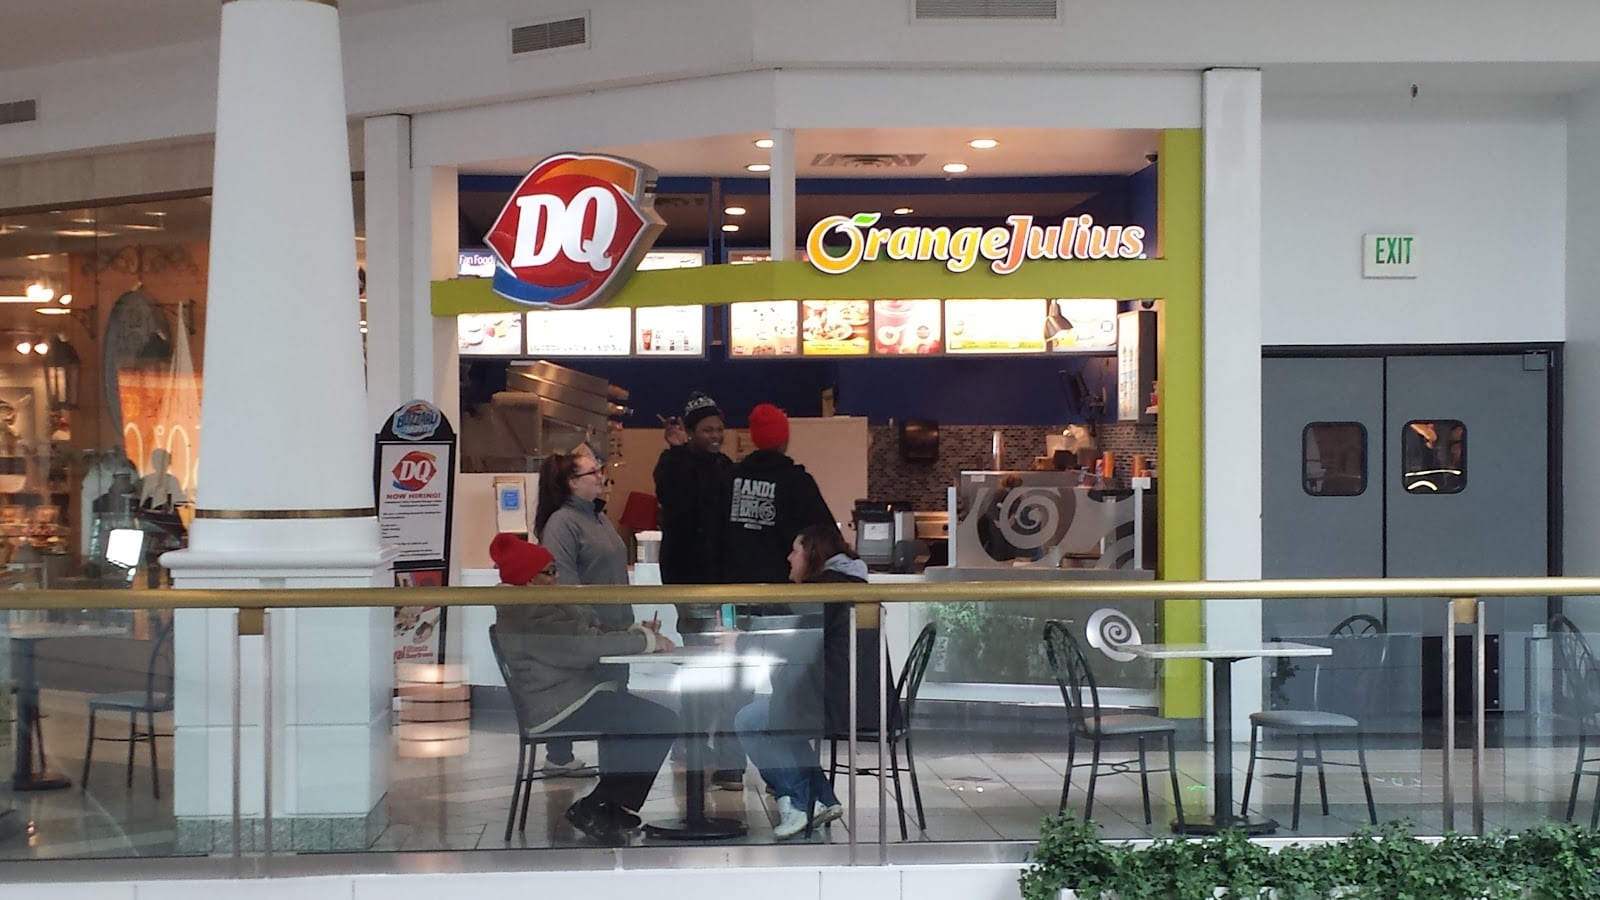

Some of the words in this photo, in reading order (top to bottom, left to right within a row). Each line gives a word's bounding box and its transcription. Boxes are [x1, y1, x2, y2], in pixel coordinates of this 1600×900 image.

[510, 186, 618, 272] DQ
[807, 212, 1010, 274] Orange
[991, 213, 1146, 275] Julius
[1375, 237, 1414, 264] EXIT
[398, 460, 432, 483] DQ
[386, 492, 407, 500] NOW
[408, 491, 441, 499] HIRING!
